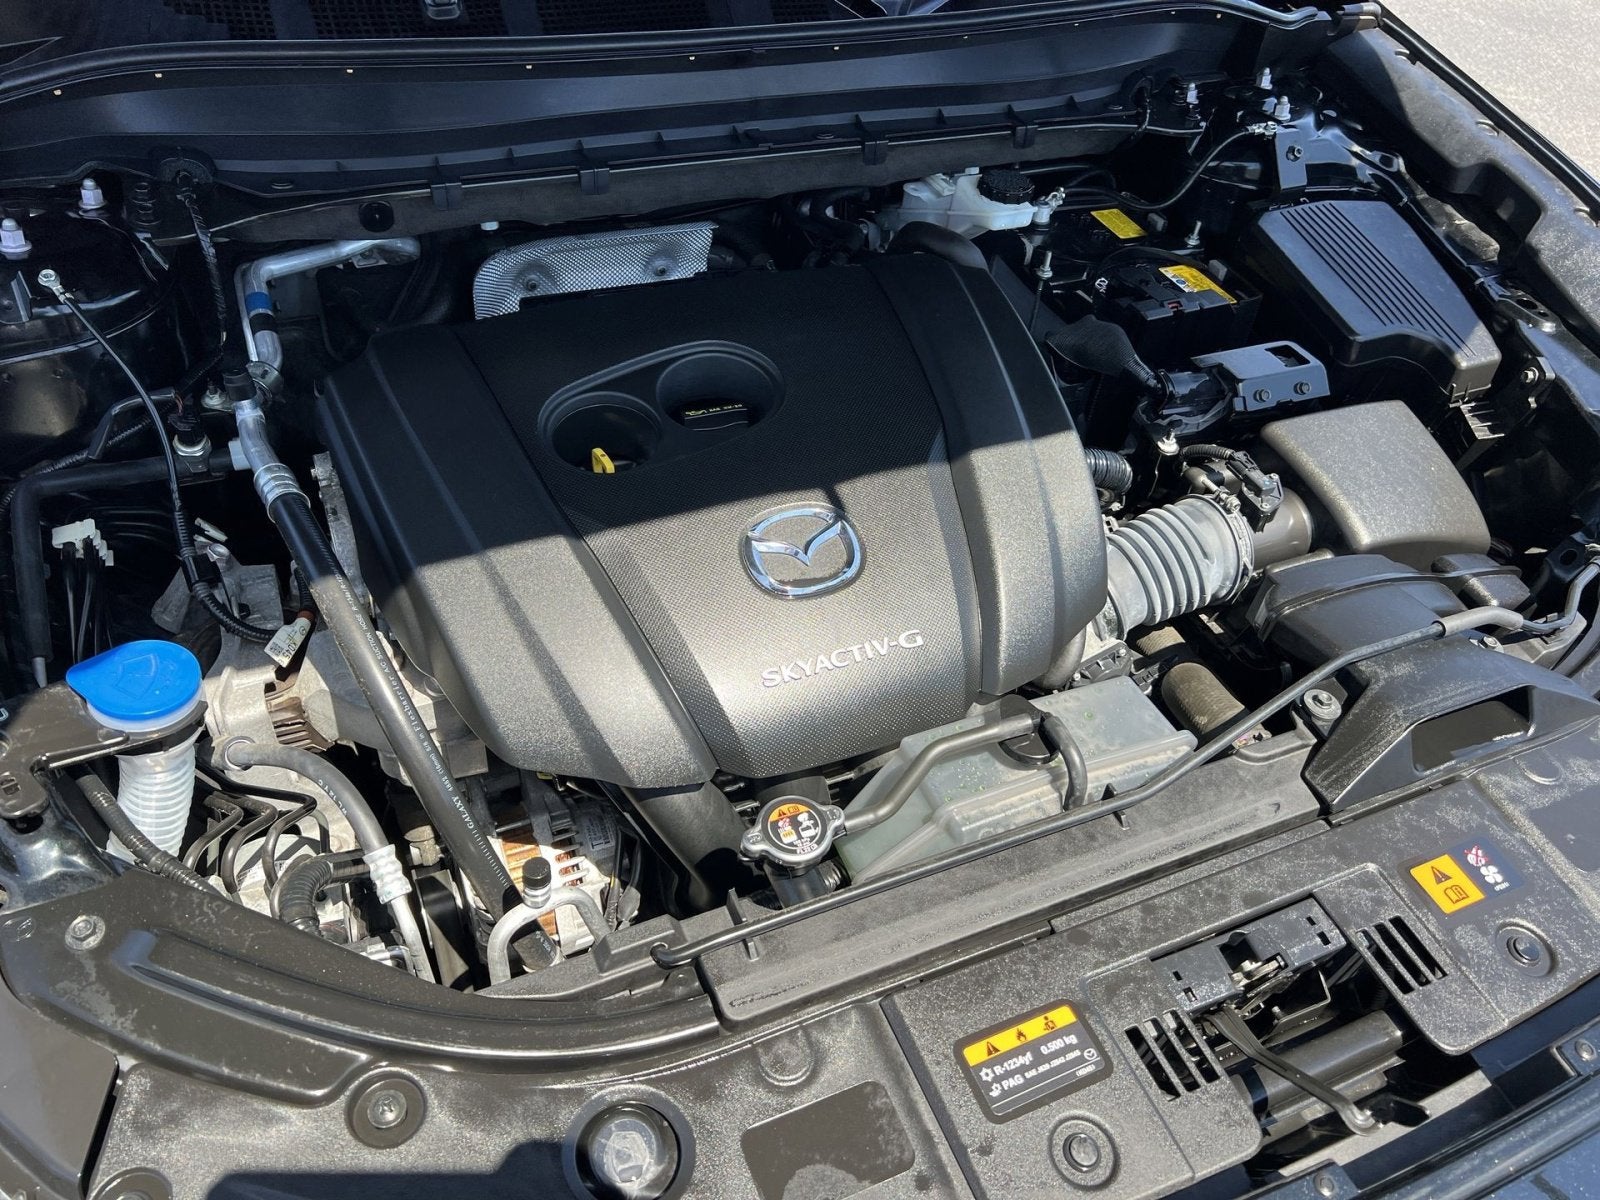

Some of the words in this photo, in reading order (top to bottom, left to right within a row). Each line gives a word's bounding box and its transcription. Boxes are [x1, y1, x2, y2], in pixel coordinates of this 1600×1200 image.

[355, 612, 369, 631] HOSE
[365, 631, 384, 660] SUCTION
[762, 629, 924, 688] SKYACTIV-G
[451, 795, 475, 830] GALAXY
[993, 1051, 1034, 1076] R-1234yf
[1039, 1038, 1064, 1056] 0.500
[1064, 1033, 1079, 1046] kg
[1001, 1074, 1024, 1091] PAG
